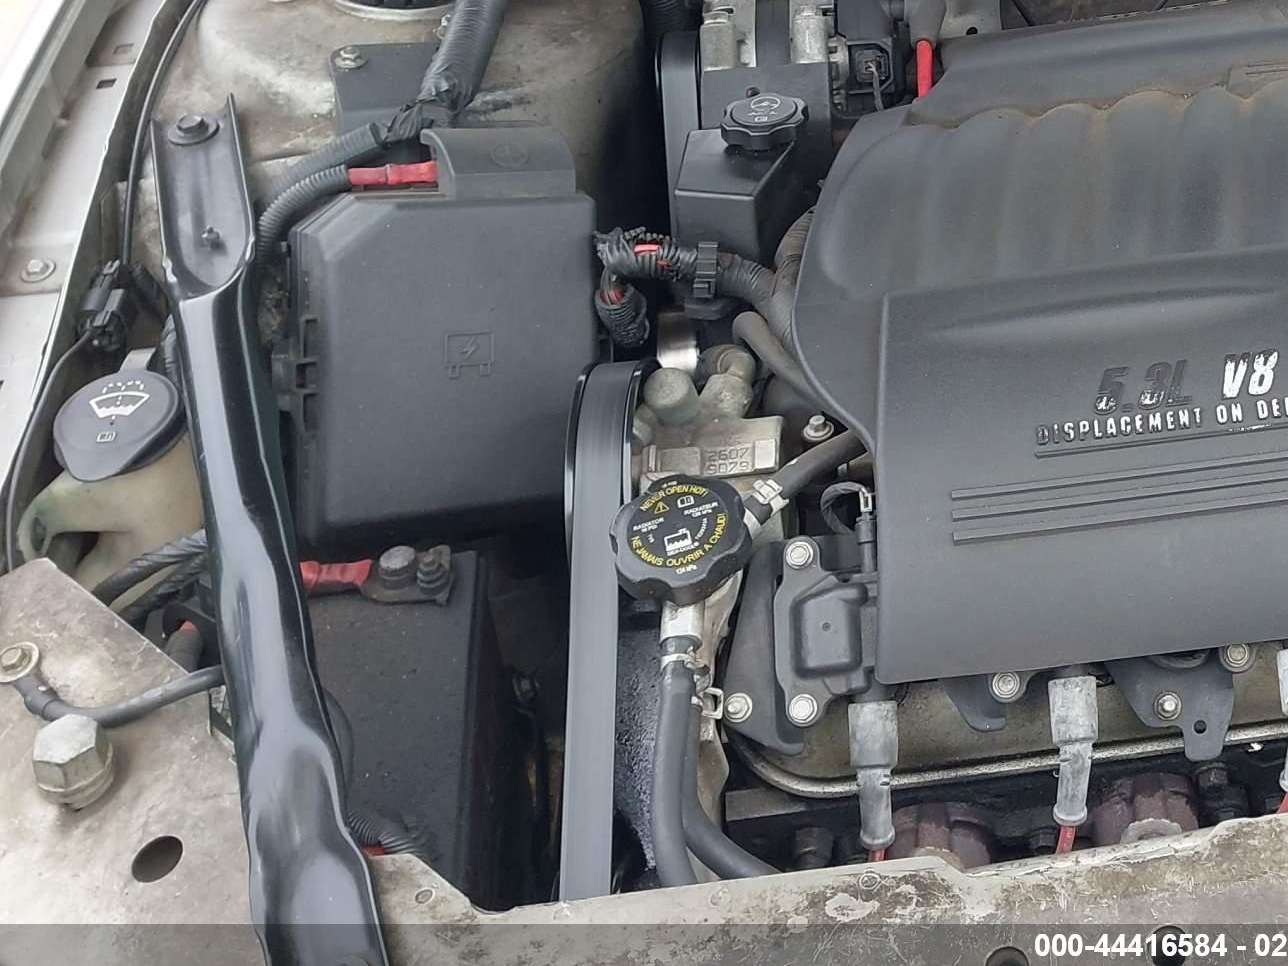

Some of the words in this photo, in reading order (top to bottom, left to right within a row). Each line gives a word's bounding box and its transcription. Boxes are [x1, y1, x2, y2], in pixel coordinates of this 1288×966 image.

[1221, 347, 1279, 400] V8
[1035, 407, 1202, 445] DISPLACEMENT
[1215, 402, 1243, 424] ON
[640, 491, 665, 511] NEVER
[665, 485, 689, 494] OPEN
[689, 485, 709, 497] HOT!
[683, 502, 718, 515] RADIATEUR
[632, 518, 664, 531] RADIATOR
[709, 513, 726, 544] CHAUD!
[631, 535, 642, 549] NE
[636, 547, 664, 566] JAMAIS
[666, 549, 705, 566] OUVRIR
